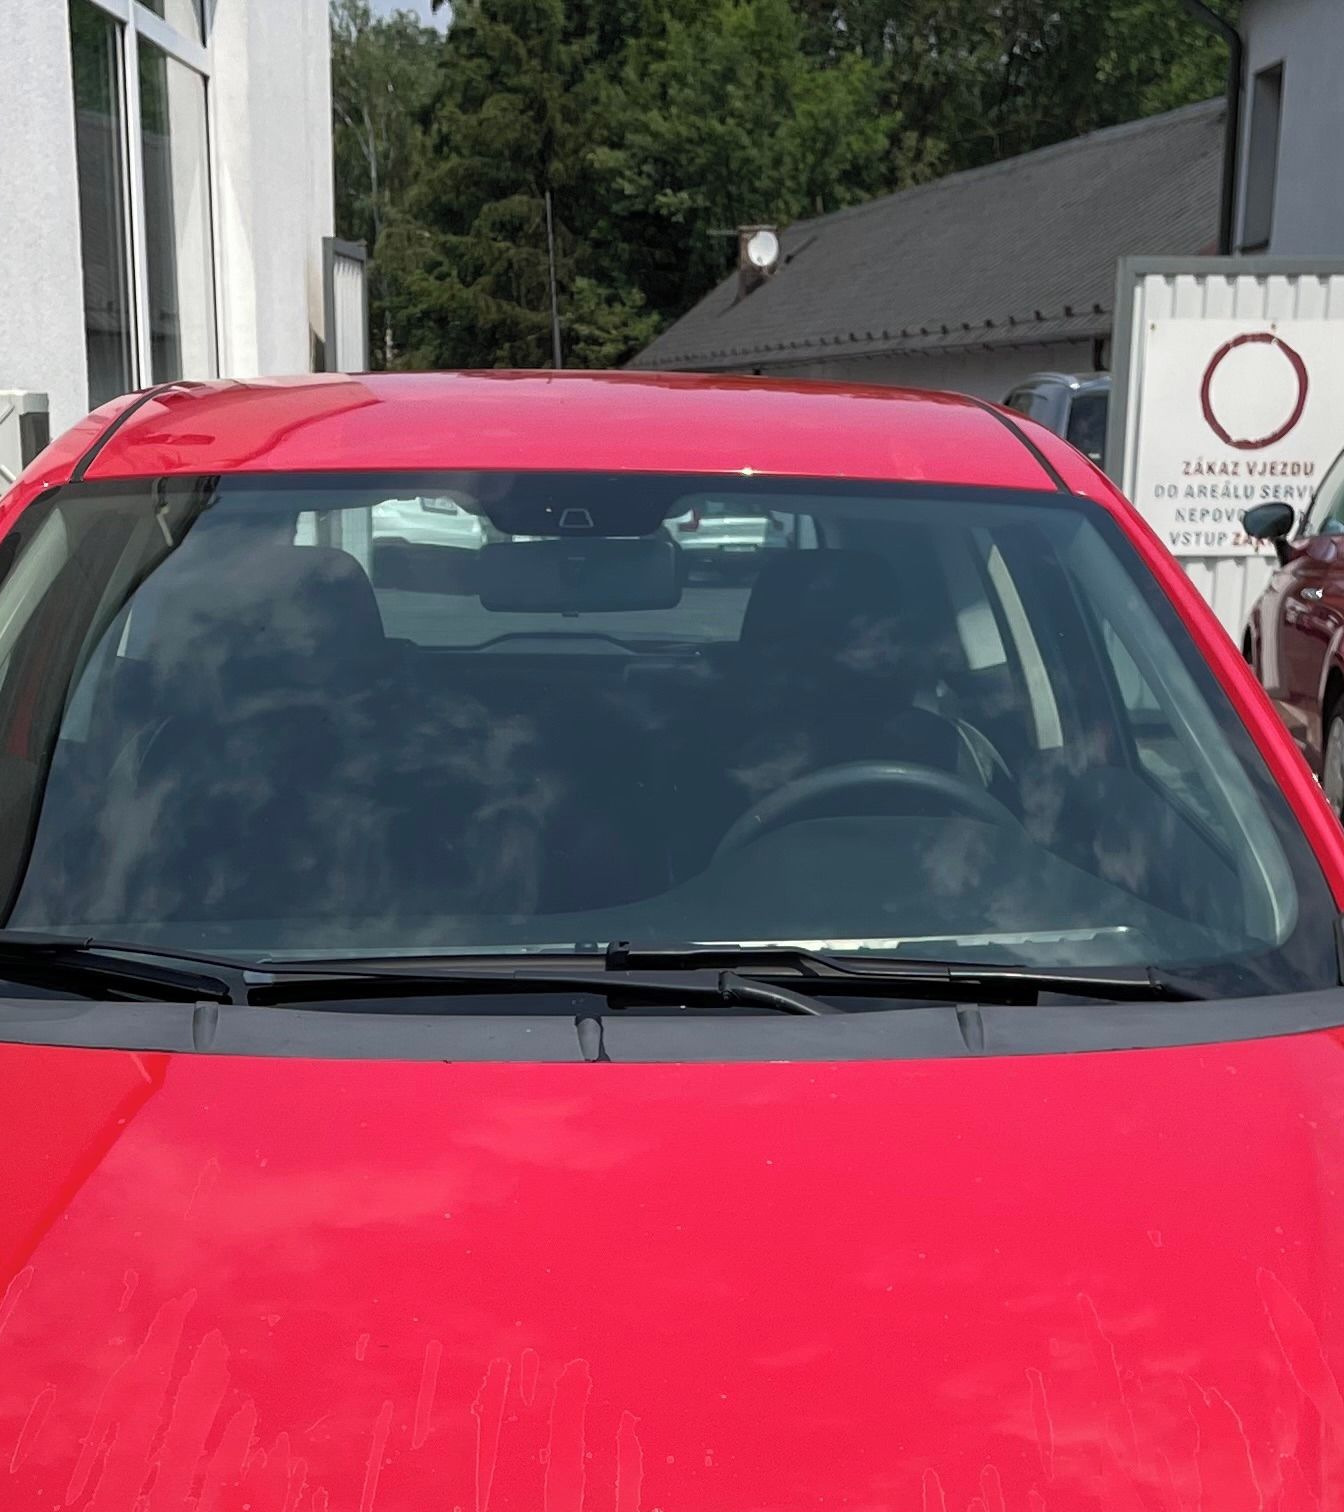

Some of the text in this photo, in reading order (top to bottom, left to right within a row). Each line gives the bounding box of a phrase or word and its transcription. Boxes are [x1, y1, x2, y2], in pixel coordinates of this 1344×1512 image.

[1182, 456, 1315, 477] ZÁKAZ VJEZDU
[1154, 484, 1179, 499] DO
[1184, 480, 1255, 500] AREÁLU
[1169, 531, 1228, 547] VSTUP
